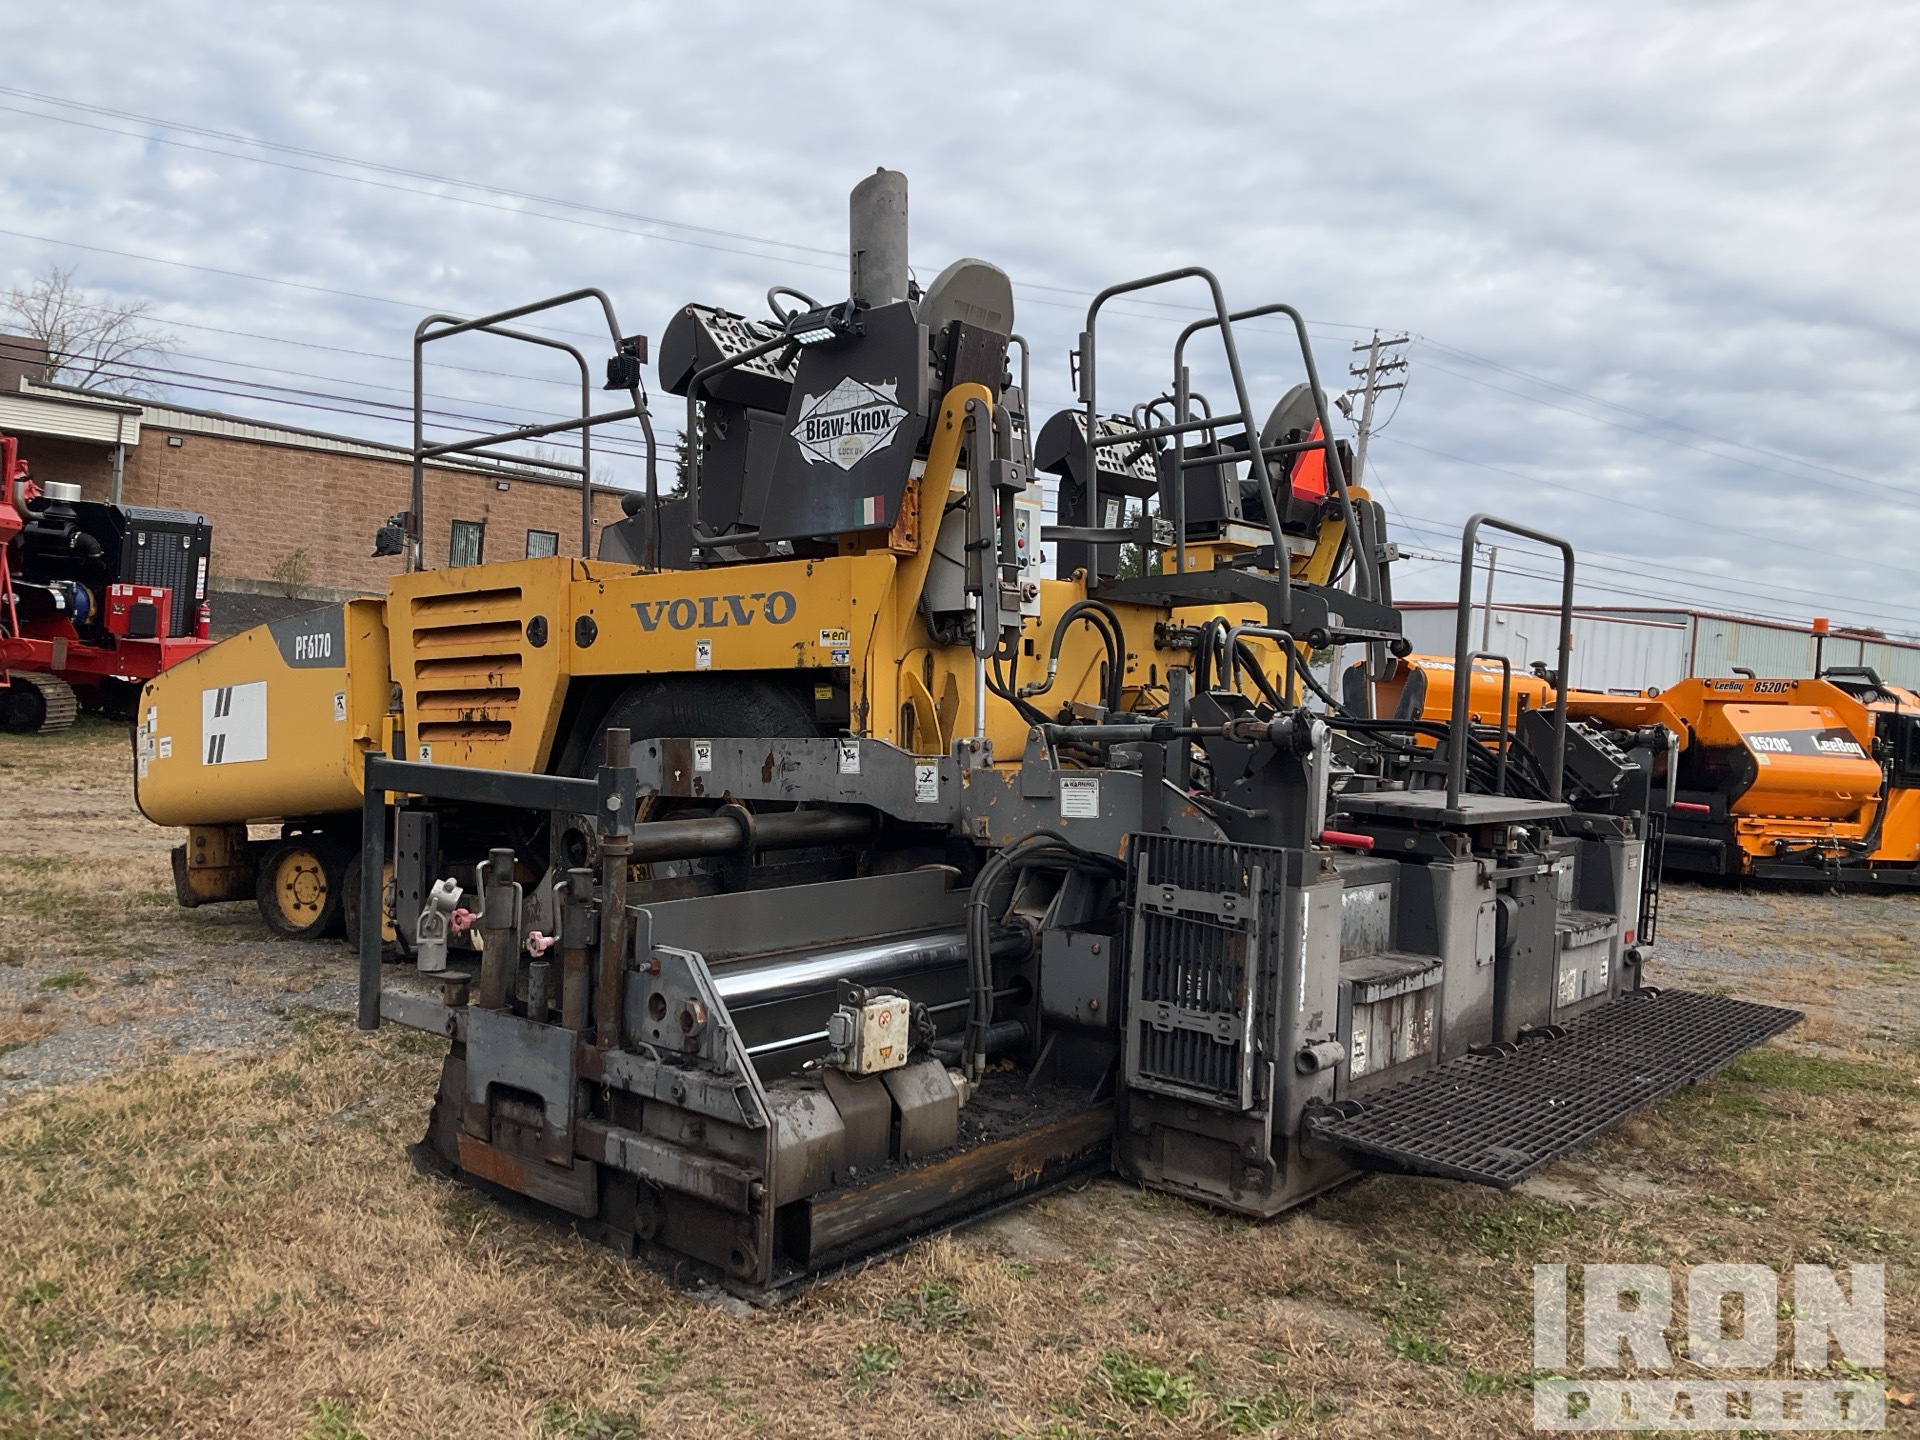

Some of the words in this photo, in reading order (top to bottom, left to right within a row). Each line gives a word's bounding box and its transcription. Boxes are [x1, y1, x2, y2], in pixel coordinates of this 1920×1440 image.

[630, 591, 797, 632] VOLVO
[295, 632, 331, 660] PF6170
[1714, 681, 1744, 692] LeeBoy
[1754, 681, 1790, 693] 8520C
[1750, 736, 1792, 752] 8520C
[1811, 735, 1867, 759] LeeBoy
